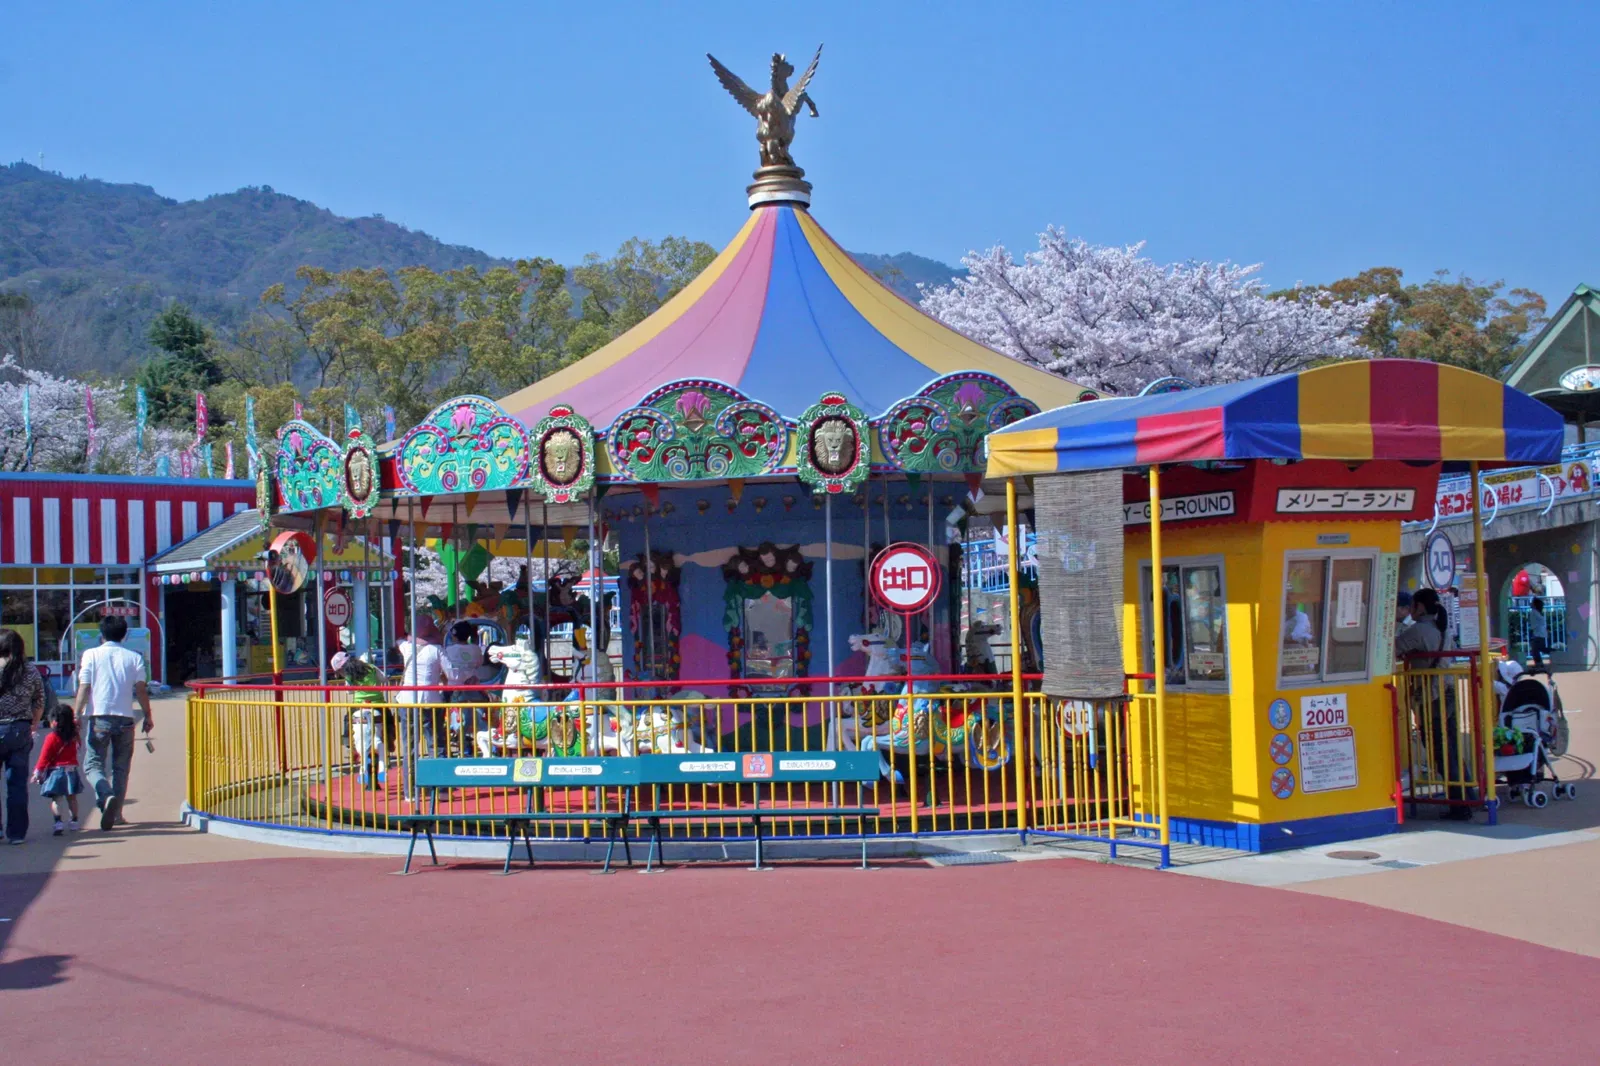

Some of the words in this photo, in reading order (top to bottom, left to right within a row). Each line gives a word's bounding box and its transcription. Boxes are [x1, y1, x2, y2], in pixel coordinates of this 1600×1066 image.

[1123, 495, 1232, 521] Y-G-ROUND
[1285, 491, 1407, 509] メリーゴーランド
[1433, 551, 1451, 572] 入口
[882, 566, 929, 591] 出口
[328, 603, 346, 615] 出口
[1310, 696, 1339, 708] お一人様
[1306, 708, 1345, 726] 200円
[688, 762, 730, 771] ルールを守って
